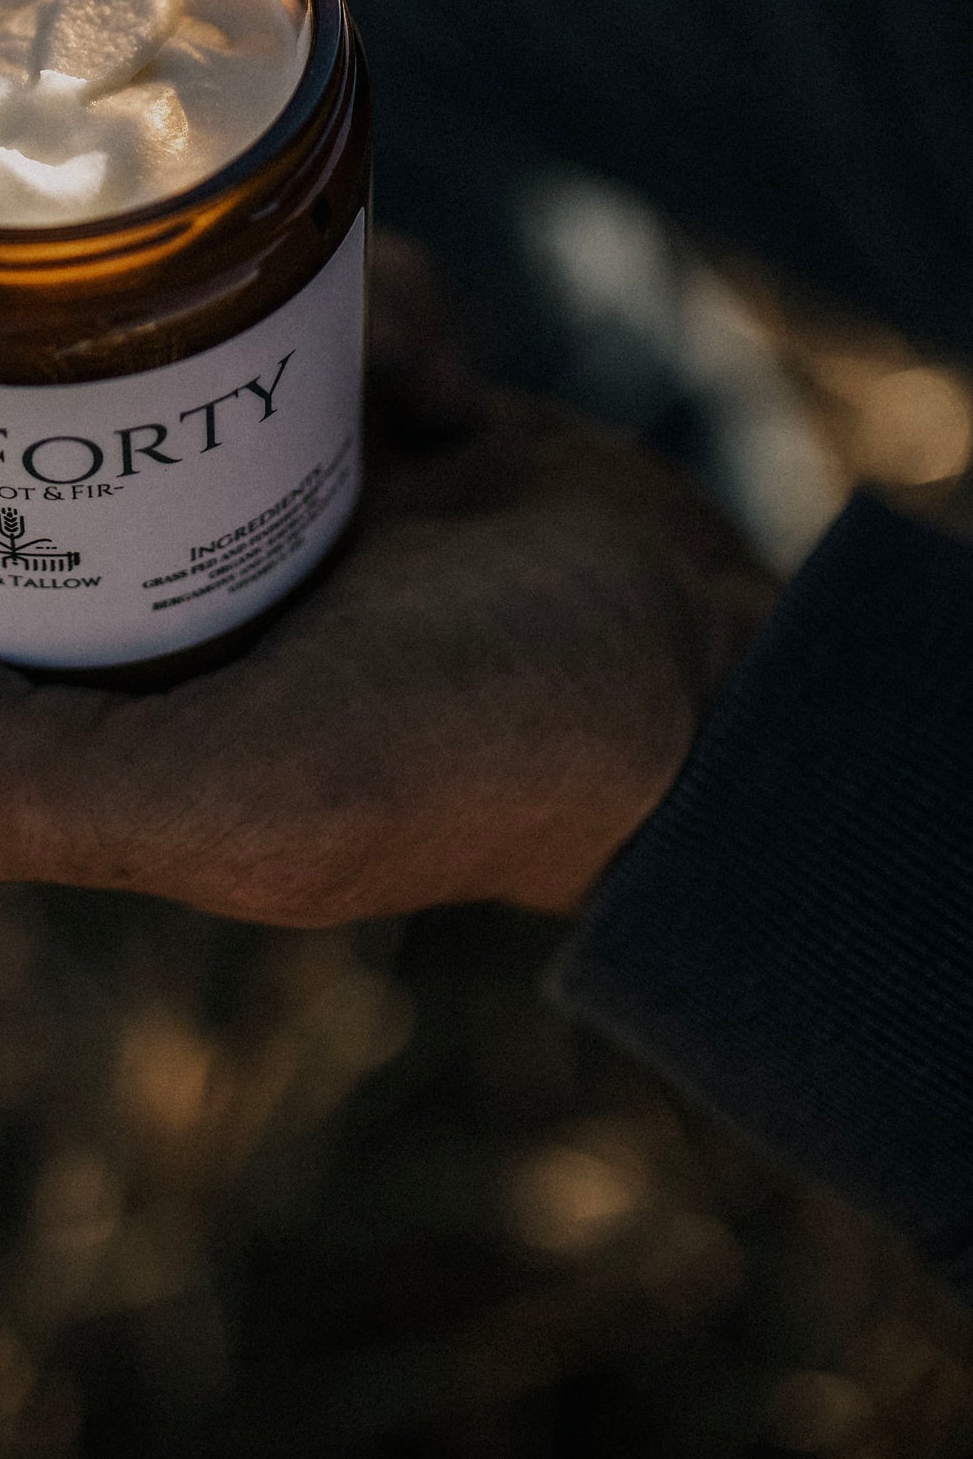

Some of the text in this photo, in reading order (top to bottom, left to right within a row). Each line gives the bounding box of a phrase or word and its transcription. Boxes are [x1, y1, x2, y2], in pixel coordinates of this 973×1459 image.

[43, 485, 65, 501] &
[8, 573, 102, 589] TALLOW
[141, 568, 188, 589] GRASS
